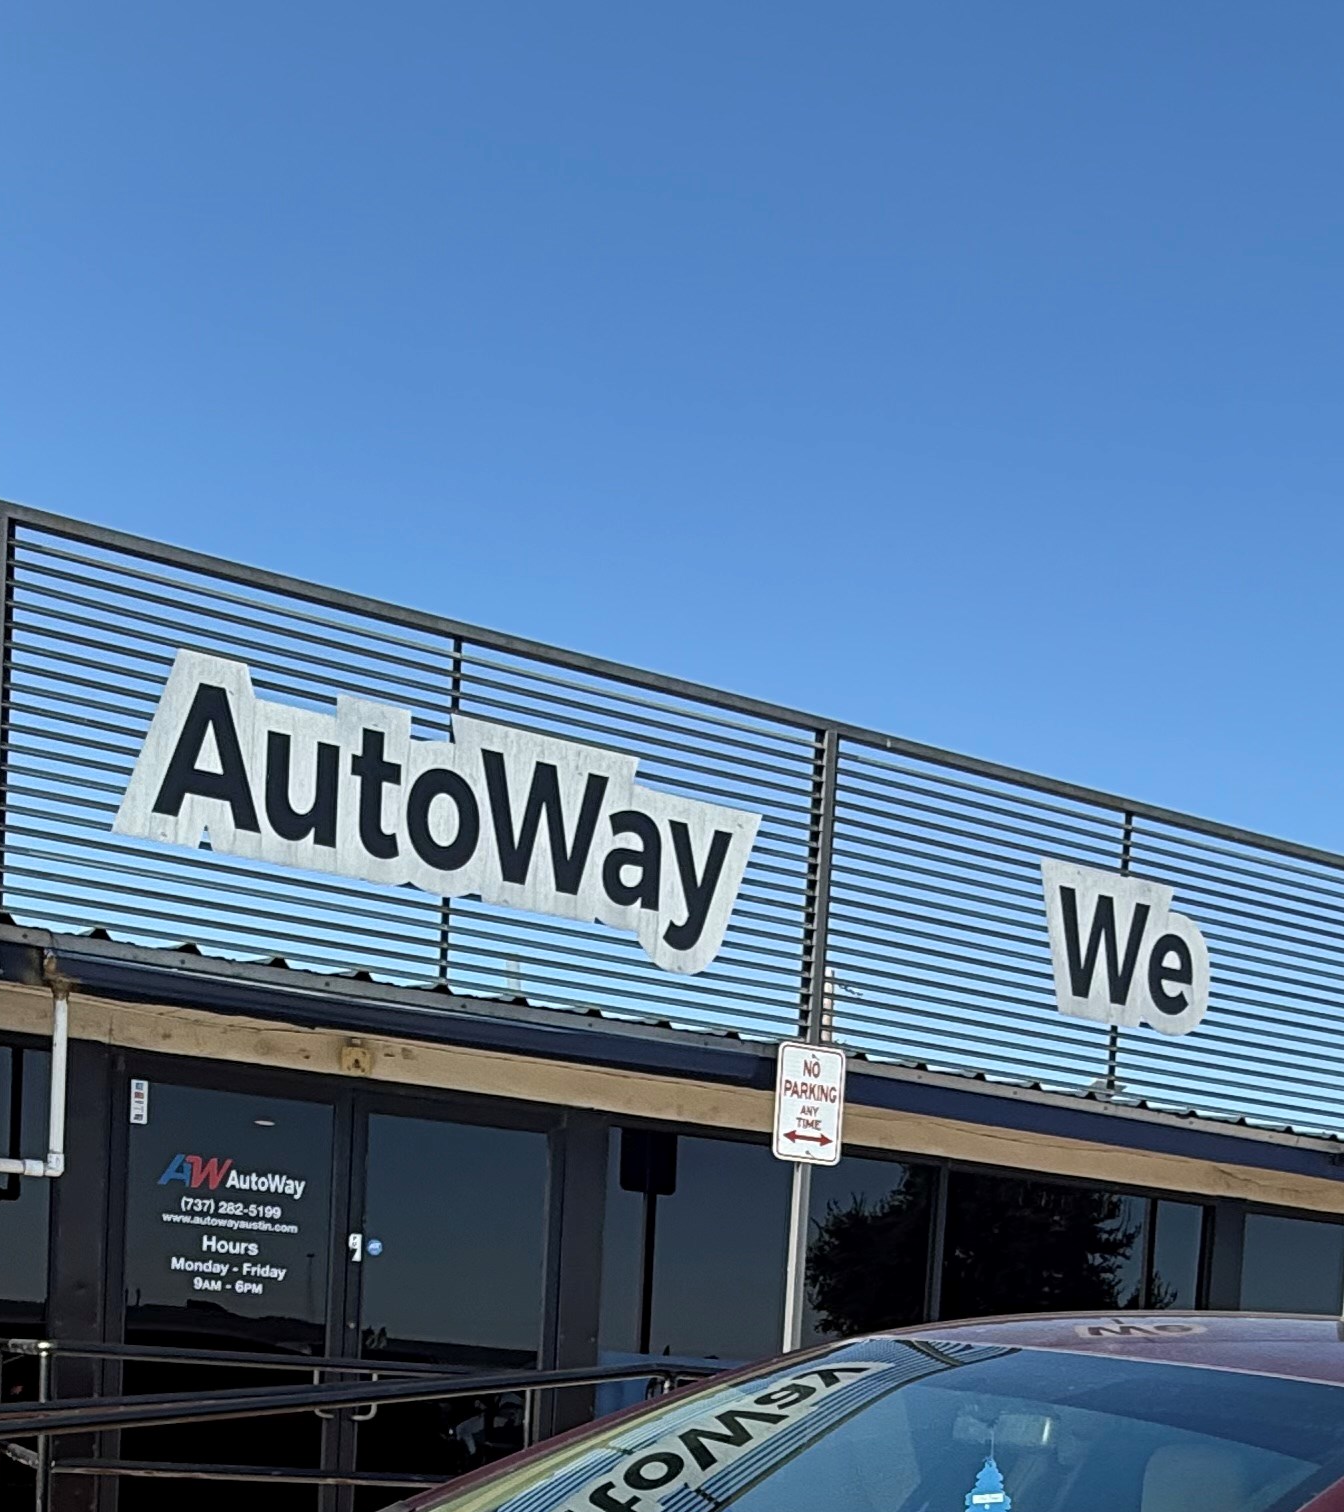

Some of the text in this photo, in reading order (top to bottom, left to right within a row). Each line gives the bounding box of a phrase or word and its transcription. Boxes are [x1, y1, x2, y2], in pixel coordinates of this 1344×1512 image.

[152, 683, 733, 951] AutoWay
[1059, 885, 1194, 1016] We
[803, 1059, 820, 1078] NO
[783, 1079, 837, 1103] PARKING
[800, 1105, 819, 1116] ANY
[796, 1117, 821, 1130] TIME
[225, 1169, 305, 1198] AutoWay
[180, 1196, 281, 1218] (737) 282-5199
[162, 1213, 297, 1233] www.autowayaustin.com
[202, 1235, 258, 1255] Hours
[170, 1256, 228, 1275] Monday
[242, 1264, 286, 1280] Friday
[193, 1277, 221, 1291] 9AM
[235, 1280, 262, 1294] 6PM
